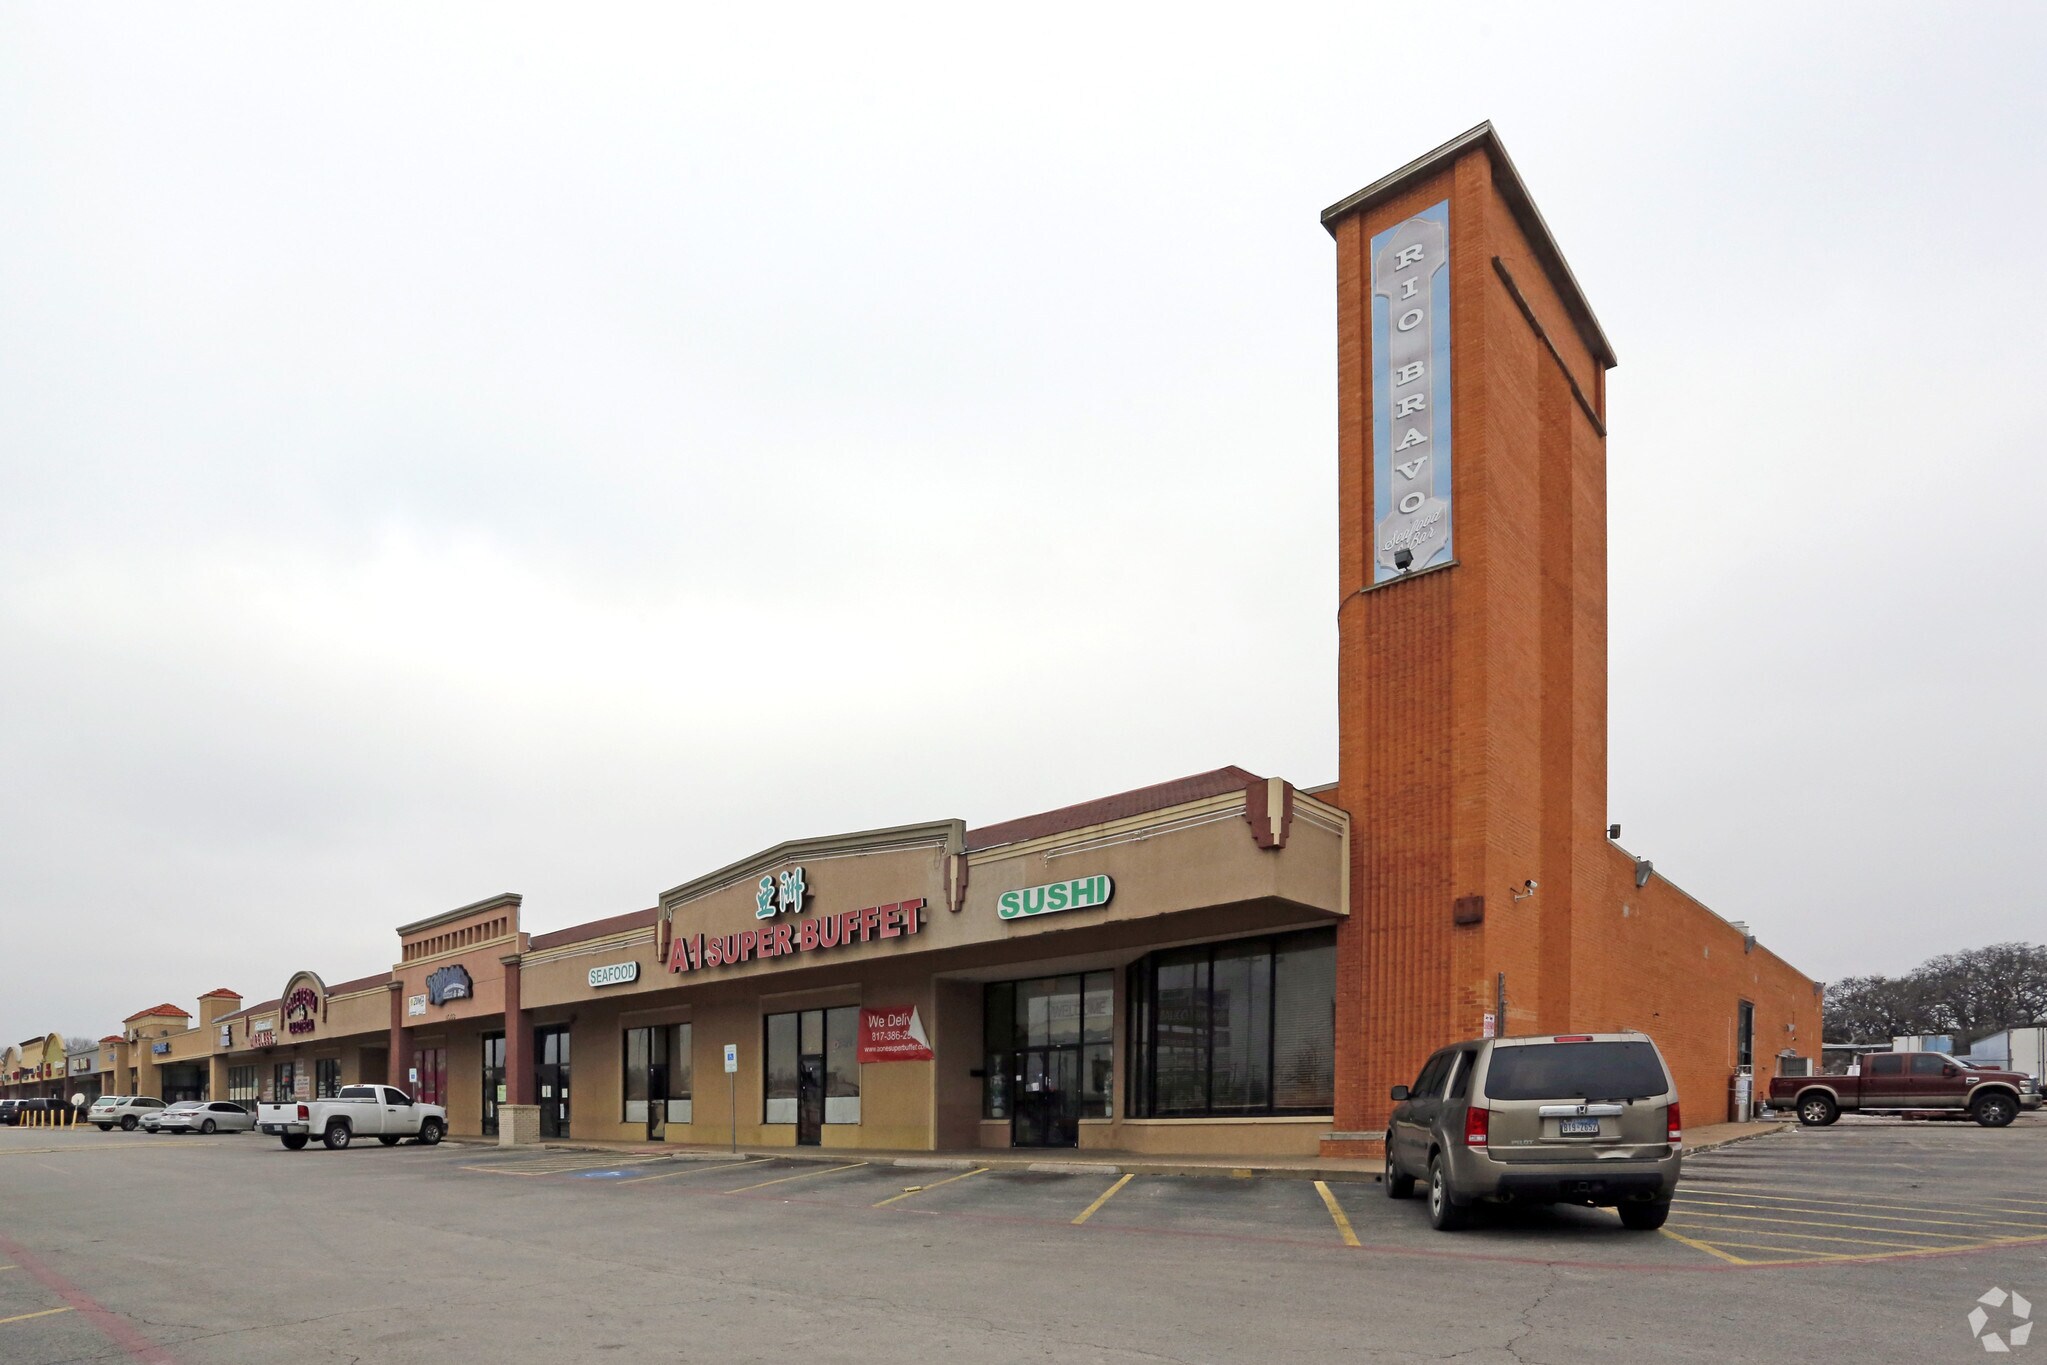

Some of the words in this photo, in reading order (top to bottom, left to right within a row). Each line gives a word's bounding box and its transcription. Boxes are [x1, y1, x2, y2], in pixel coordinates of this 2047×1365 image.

[1395, 243, 1425, 332] RIO
[1395, 360, 1429, 514] BRAVO
[1382, 508, 1441, 552] Seafood
[1409, 527, 1436, 551] Bar
[1000, 875, 1106, 918] SUSHI
[707, 923, 793, 967] SUPER
[800, 898, 924, 952] BUFFET
[590, 963, 635, 985] SEAFOOD
[868, 1015, 885, 1028] We
